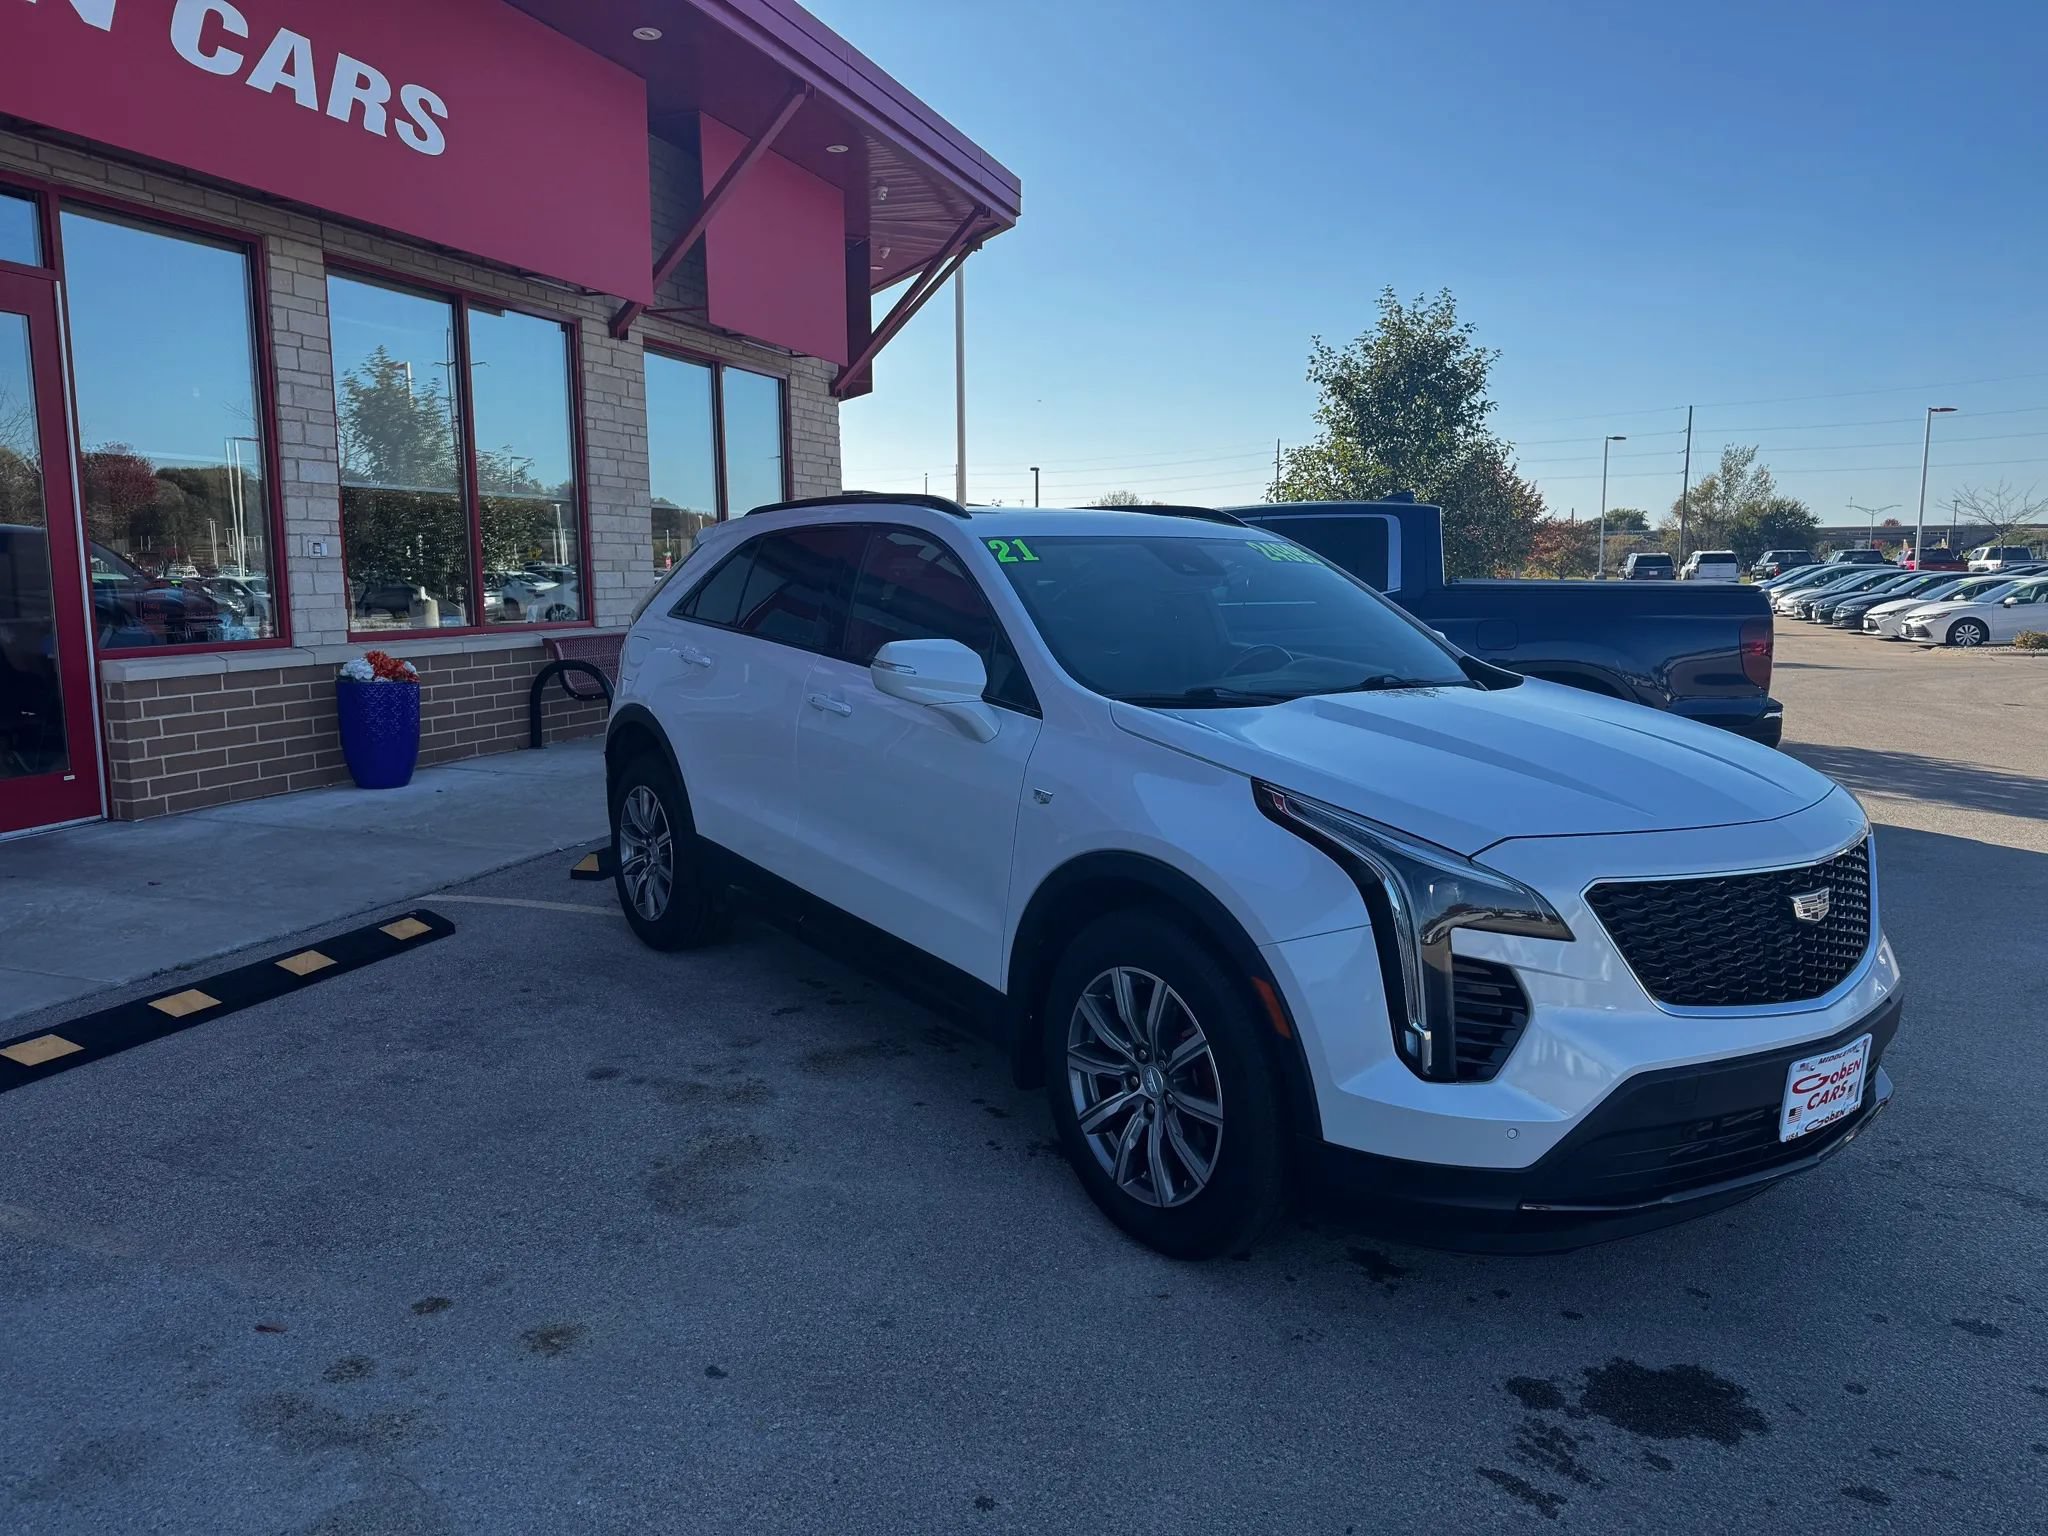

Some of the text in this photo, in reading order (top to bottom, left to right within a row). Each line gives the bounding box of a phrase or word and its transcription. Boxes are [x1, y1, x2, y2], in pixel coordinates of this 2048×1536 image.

[169, 0, 449, 156] CARS
[988, 539, 1040, 563] 21
[1807, 1080, 1848, 1110] CARS
